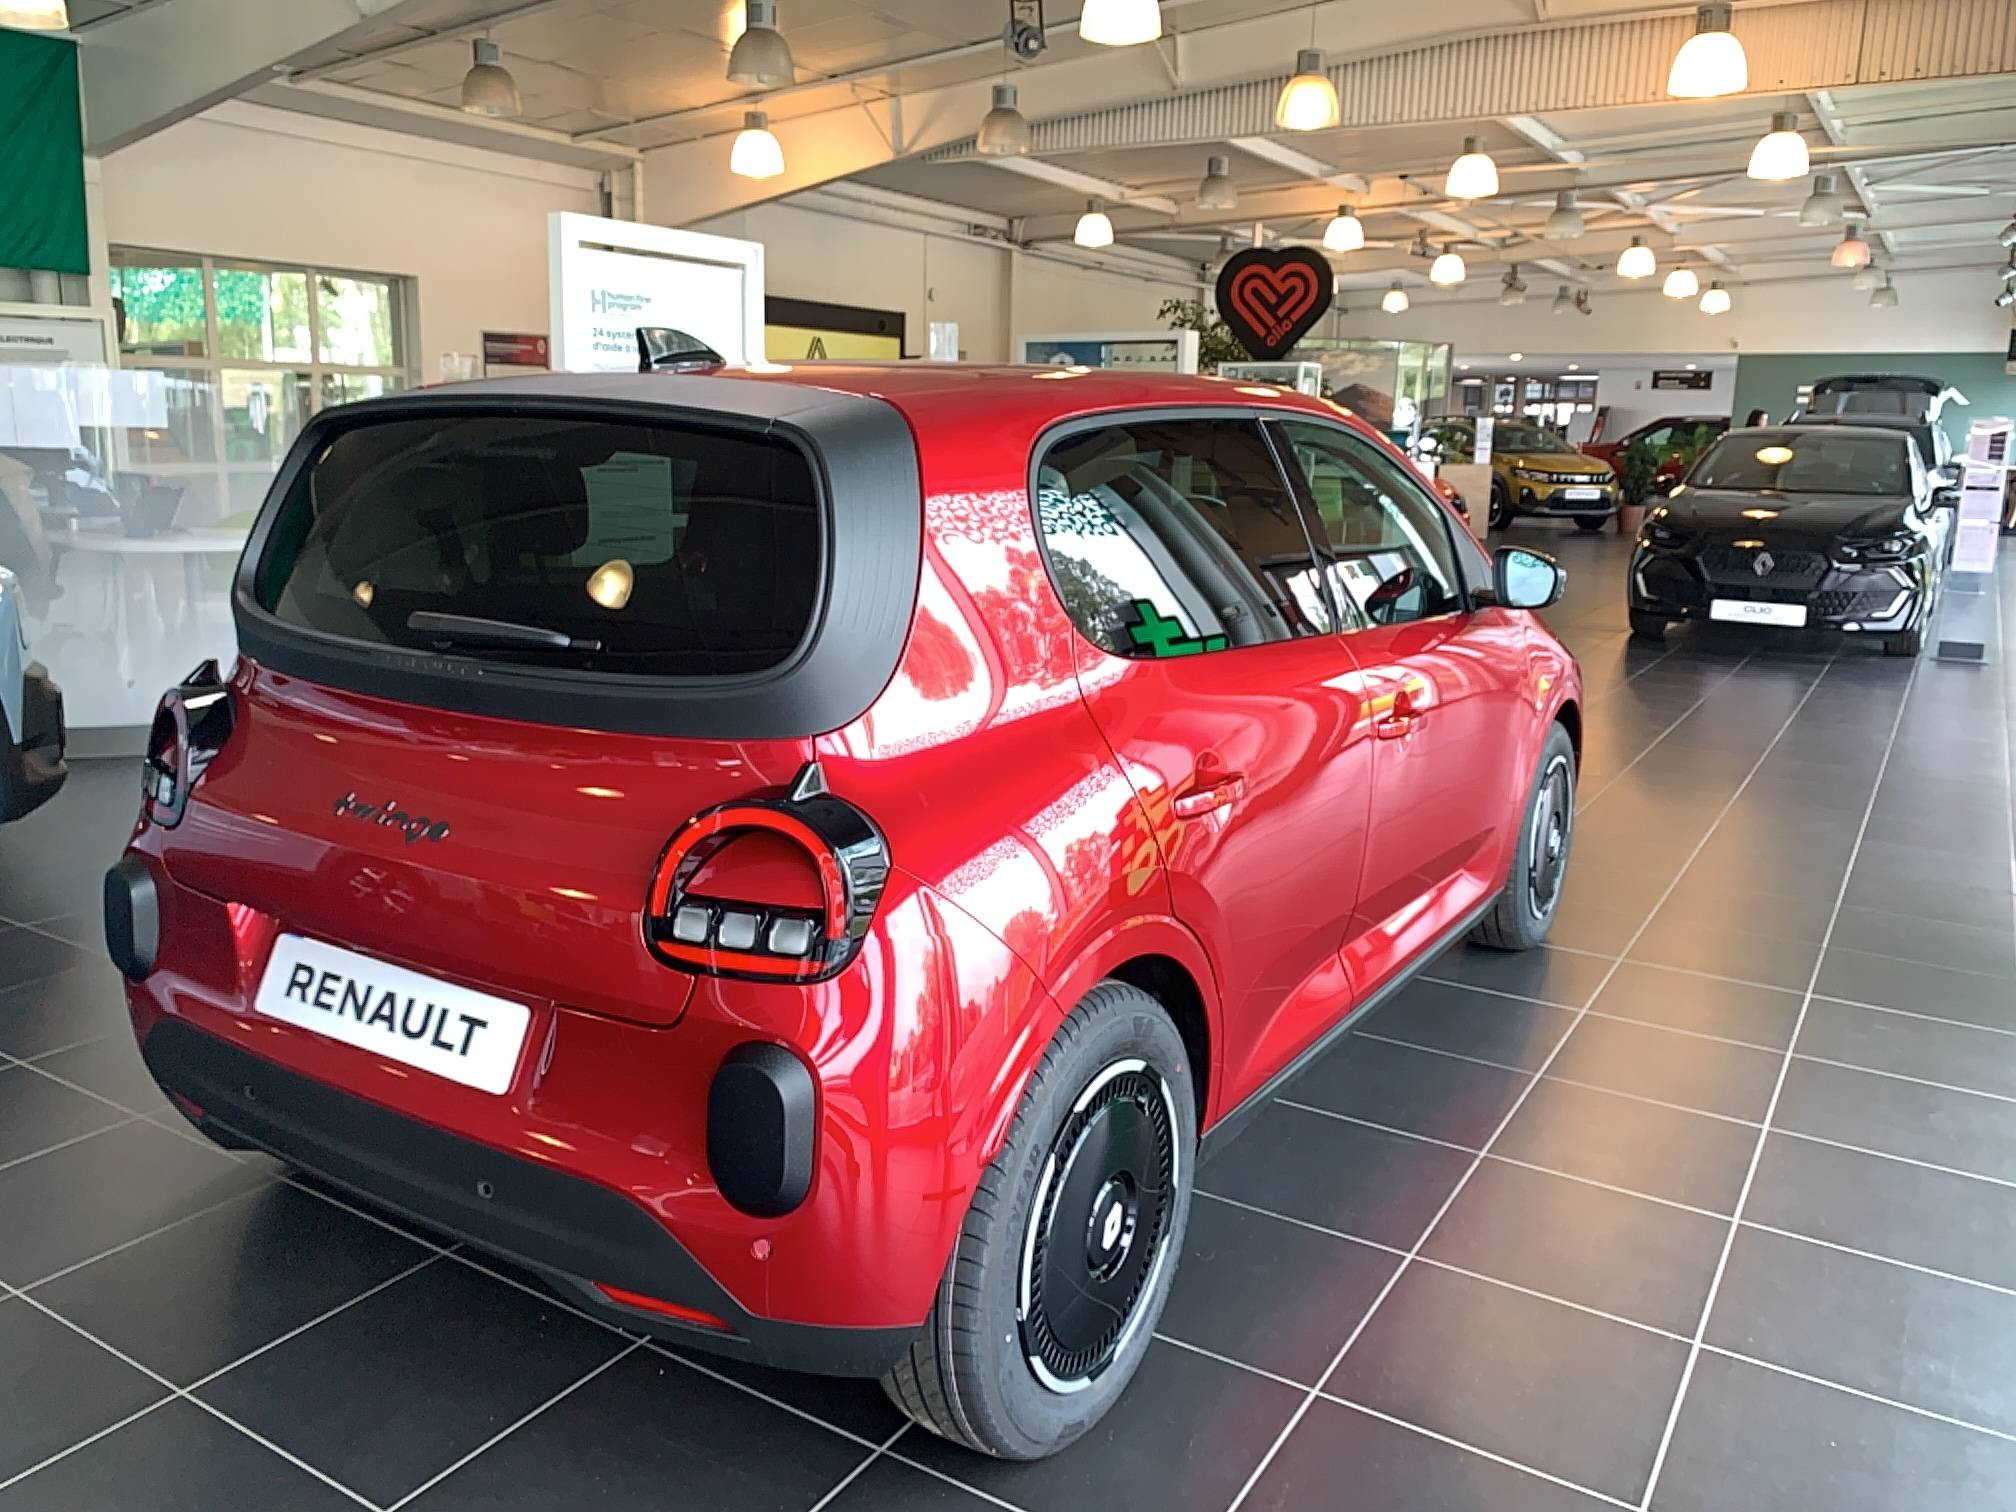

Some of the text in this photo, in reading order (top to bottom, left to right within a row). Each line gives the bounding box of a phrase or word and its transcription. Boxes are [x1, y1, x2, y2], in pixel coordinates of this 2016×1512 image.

[593, 328, 604, 337] 24
[1266, 320, 1293, 347] clio
[1743, 605, 1773, 615] CLIO
[335, 792, 450, 844] twingo
[285, 961, 489, 1057] RENAULT
